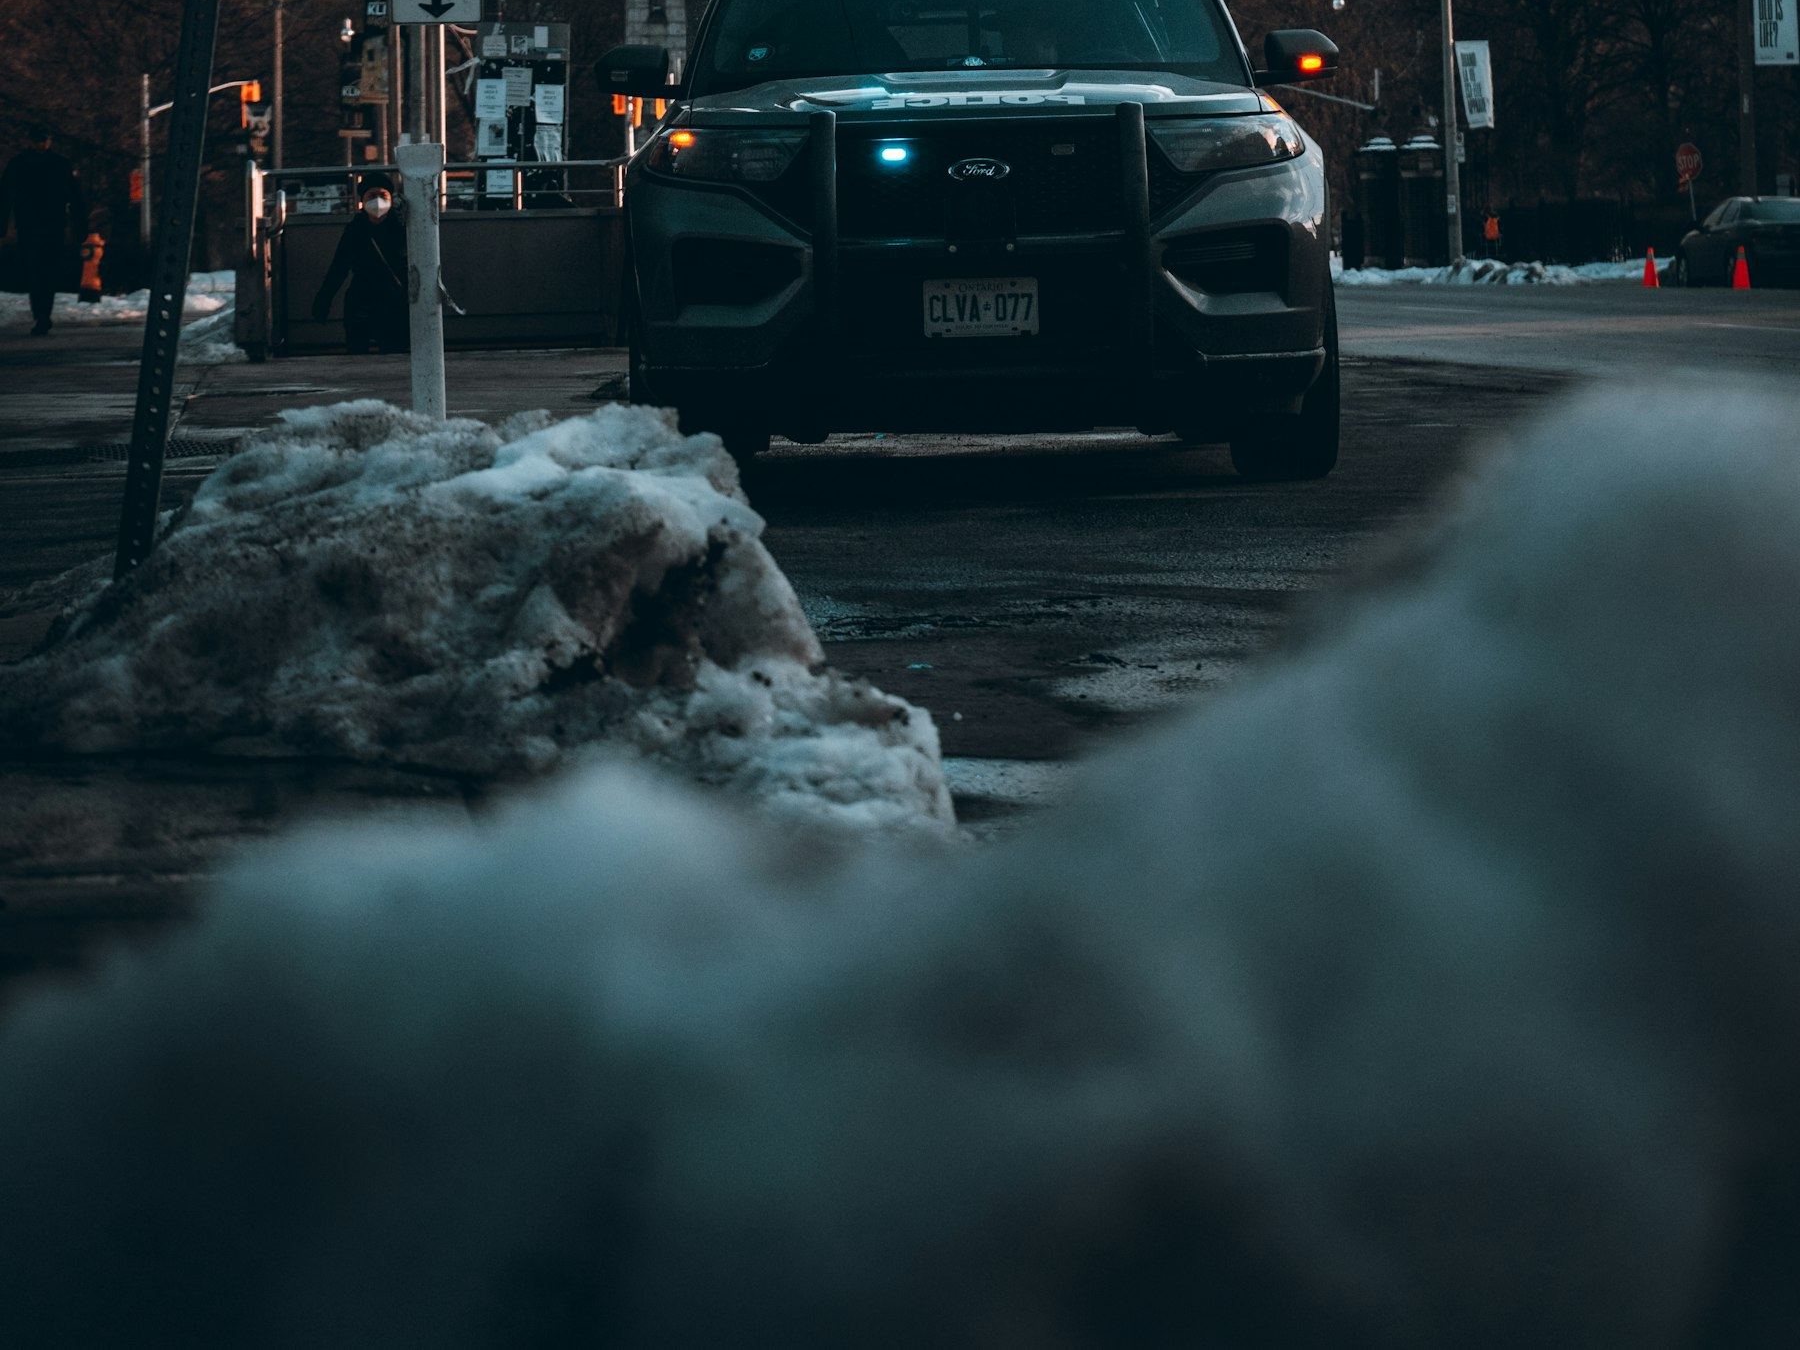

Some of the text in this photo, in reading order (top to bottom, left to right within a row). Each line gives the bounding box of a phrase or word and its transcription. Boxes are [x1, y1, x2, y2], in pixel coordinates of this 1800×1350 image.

[962, 163, 995, 176] Ford
[958, 282, 1004, 293] ONTARIO
[929, 292, 1033, 322] CLVA 077
